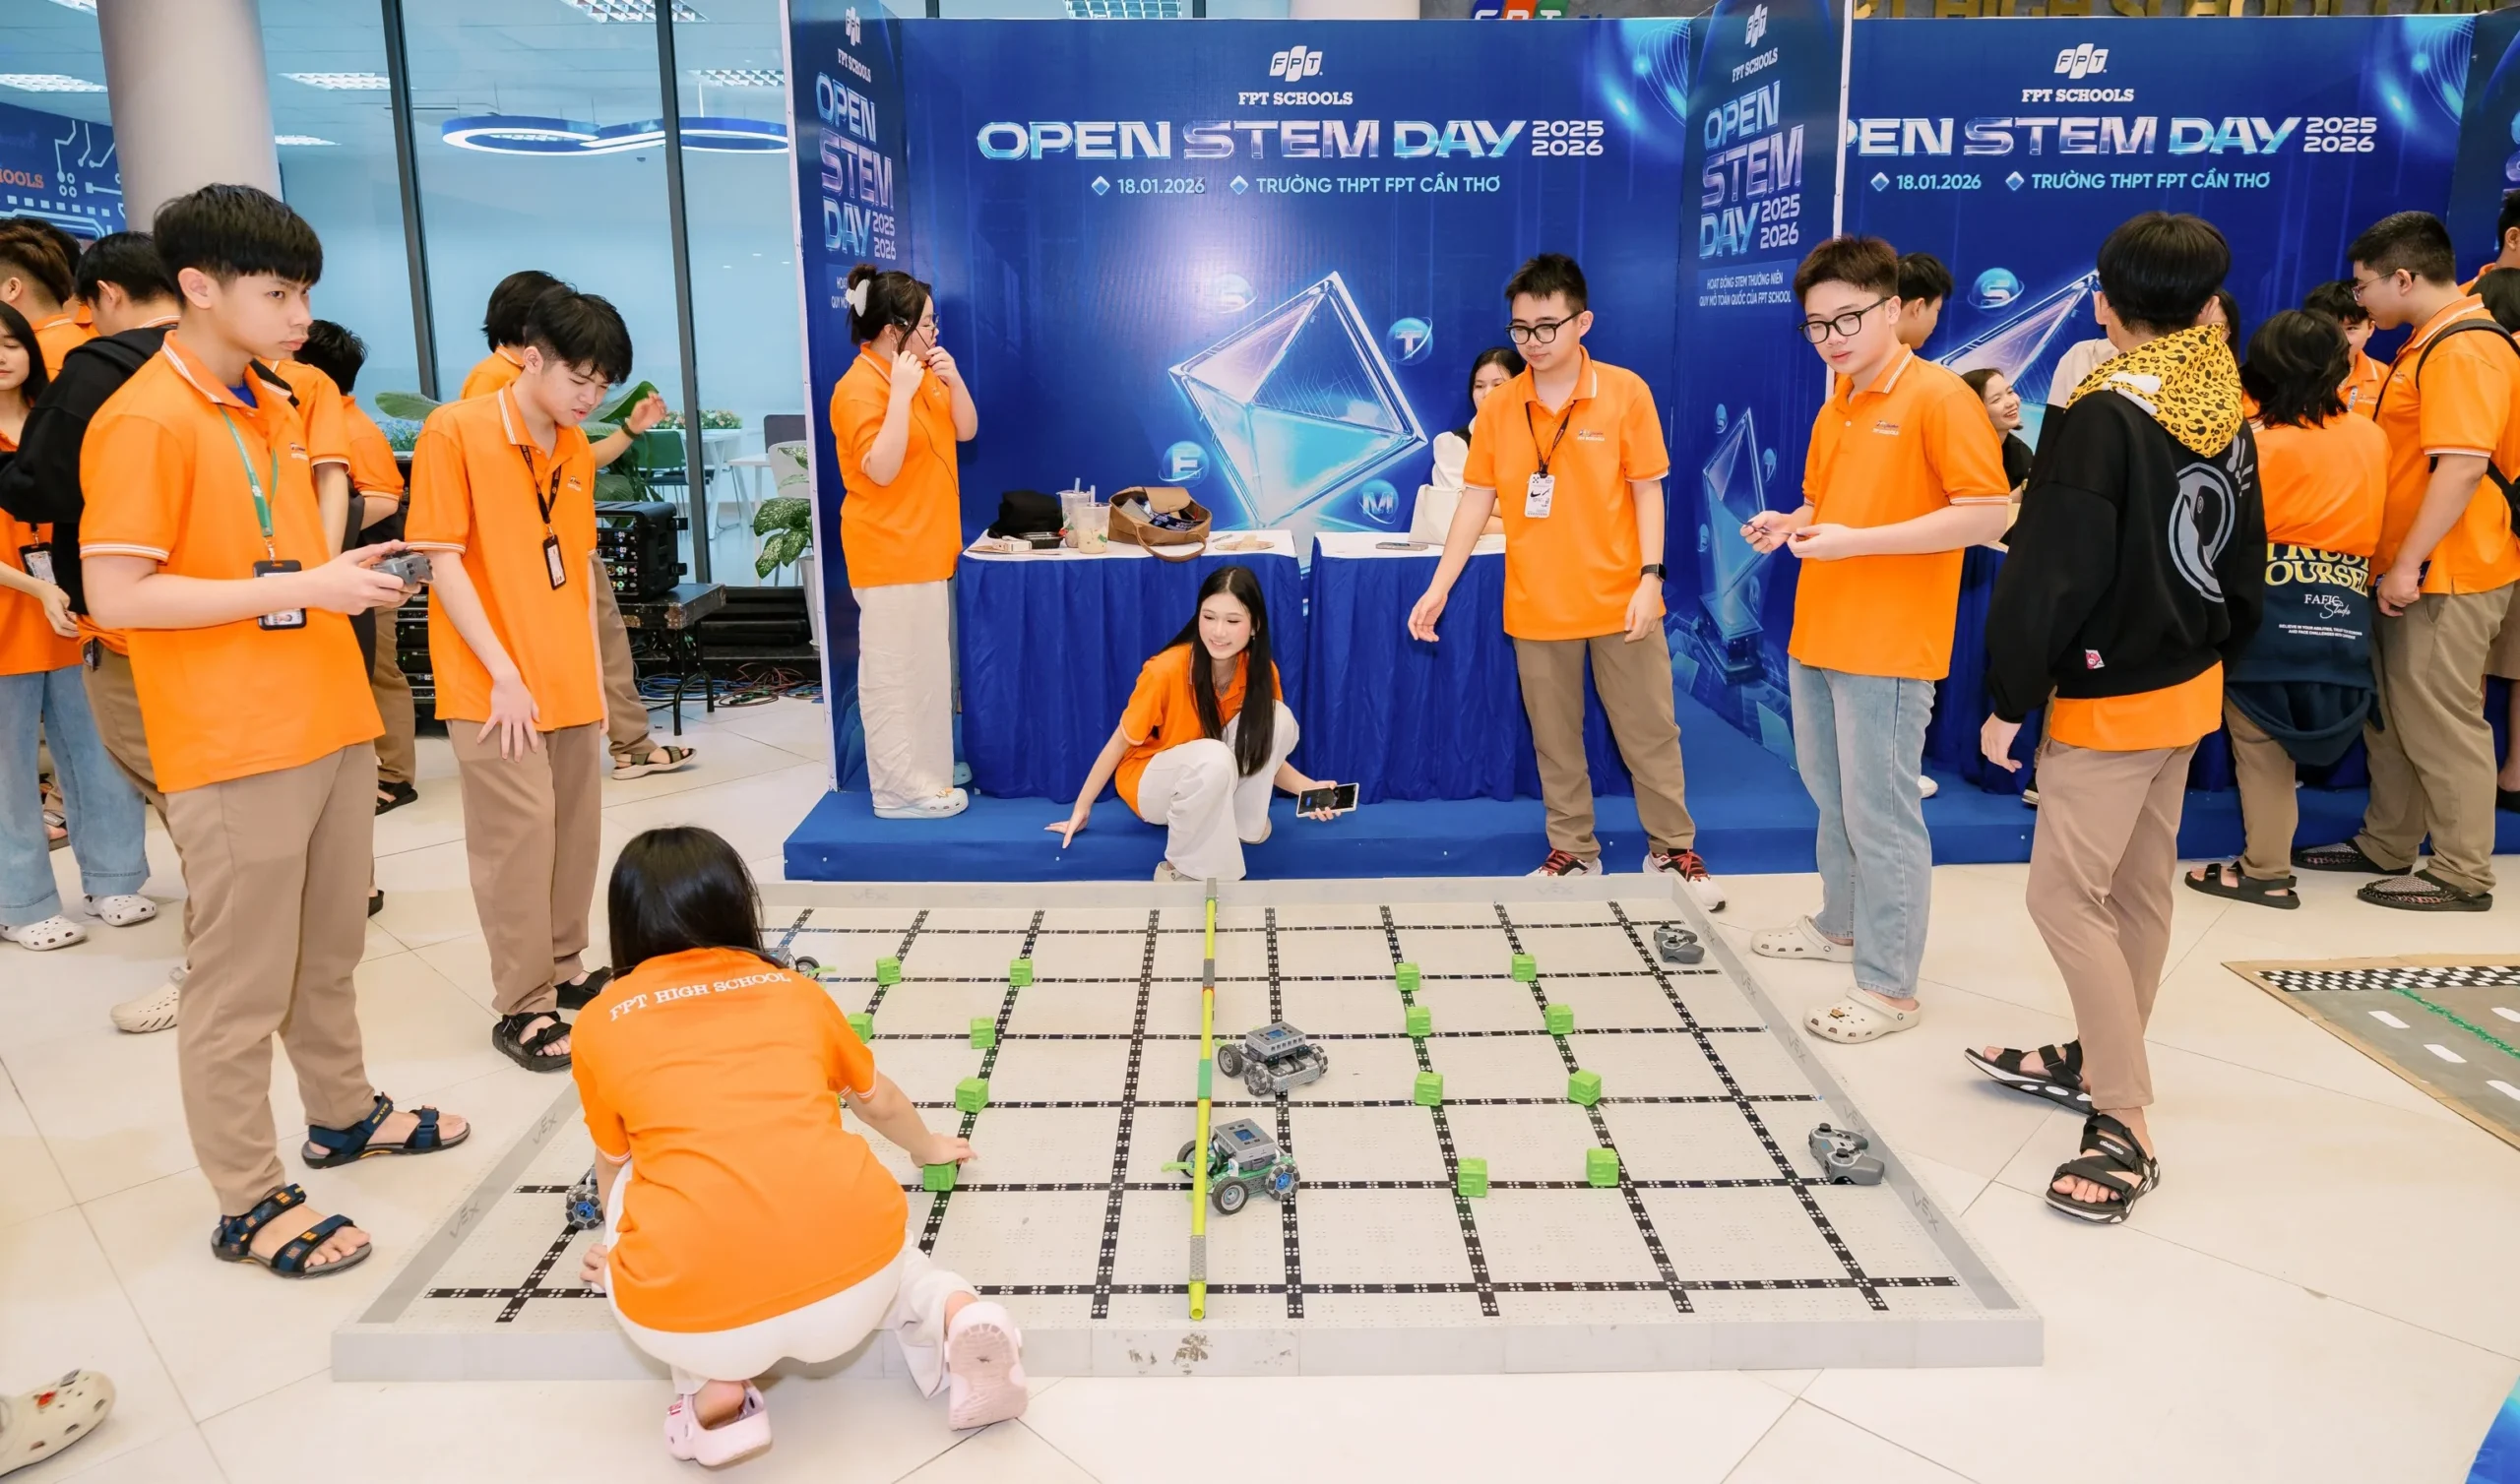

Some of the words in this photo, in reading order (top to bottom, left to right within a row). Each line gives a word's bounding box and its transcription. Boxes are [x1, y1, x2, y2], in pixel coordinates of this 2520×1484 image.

[1270, 45, 1323, 82] FPT
[1732, 64, 1744, 83] FPT
[1745, 47, 1778, 76] SCHOOLS
[2054, 43, 2109, 79] FPT
[816, 72, 876, 145] OPEN
[1238, 93, 1269, 105] FPT
[1274, 92, 1354, 105] SCHOOLS
[2021, 89, 2052, 102] FPT
[2055, 89, 2134, 102] SCHOOLS
[1532, 120, 1605, 138] 2025
[1704, 80, 1780, 151] OPEN
[2305, 116, 2377, 134] 2025
[977, 120, 1171, 160] OPEN
[1183, 120, 1380, 159] STEM
[1393, 119, 1527, 158] DAY
[1532, 139, 1605, 156] 2026
[1964, 116, 2159, 155] STEM
[2168, 116, 2301, 155] DAY
[2303, 136, 2375, 153] 2026
[819, 128, 894, 212] STEM
[1701, 124, 1804, 209] STEM
[2032, 169, 2106, 190] TRƯỜNG
[2110, 172, 2152, 189] THPT
[2157, 172, 2187, 189] FPT
[2191, 167, 2230, 188] CẦN
[2234, 171, 2270, 188] THƠ
[1117, 178, 1206, 195] 18.01.2026
[1256, 174, 1332, 194] TRƯỜNG
[1337, 177, 1380, 193] THPT
[1385, 177, 1417, 192] FPT
[1419, 171, 1458, 193] CẦN
[1463, 175, 1500, 192] THƠ
[1896, 174, 1982, 190] 18.01.2026
[1761, 194, 1800, 222] 2025
[823, 196, 871, 258] DAY
[872, 212, 895, 237] 2025
[1699, 202, 1759, 260] DAY
[1760, 221, 1799, 249] 2026
[874, 236, 896, 260] 2026
[1768, 290, 1792, 303] SCHOOL
[1395, 330, 1423, 359] T
[1171, 447, 1200, 479] E
[1362, 491, 1394, 514] M
[609, 994, 648, 1021] FPT
[654, 984, 711, 1004] HIGH
[714, 972, 791, 993] SCHOOL
[450, 1200, 481, 1238] VEX
[1913, 1190, 1939, 1232] VEX
